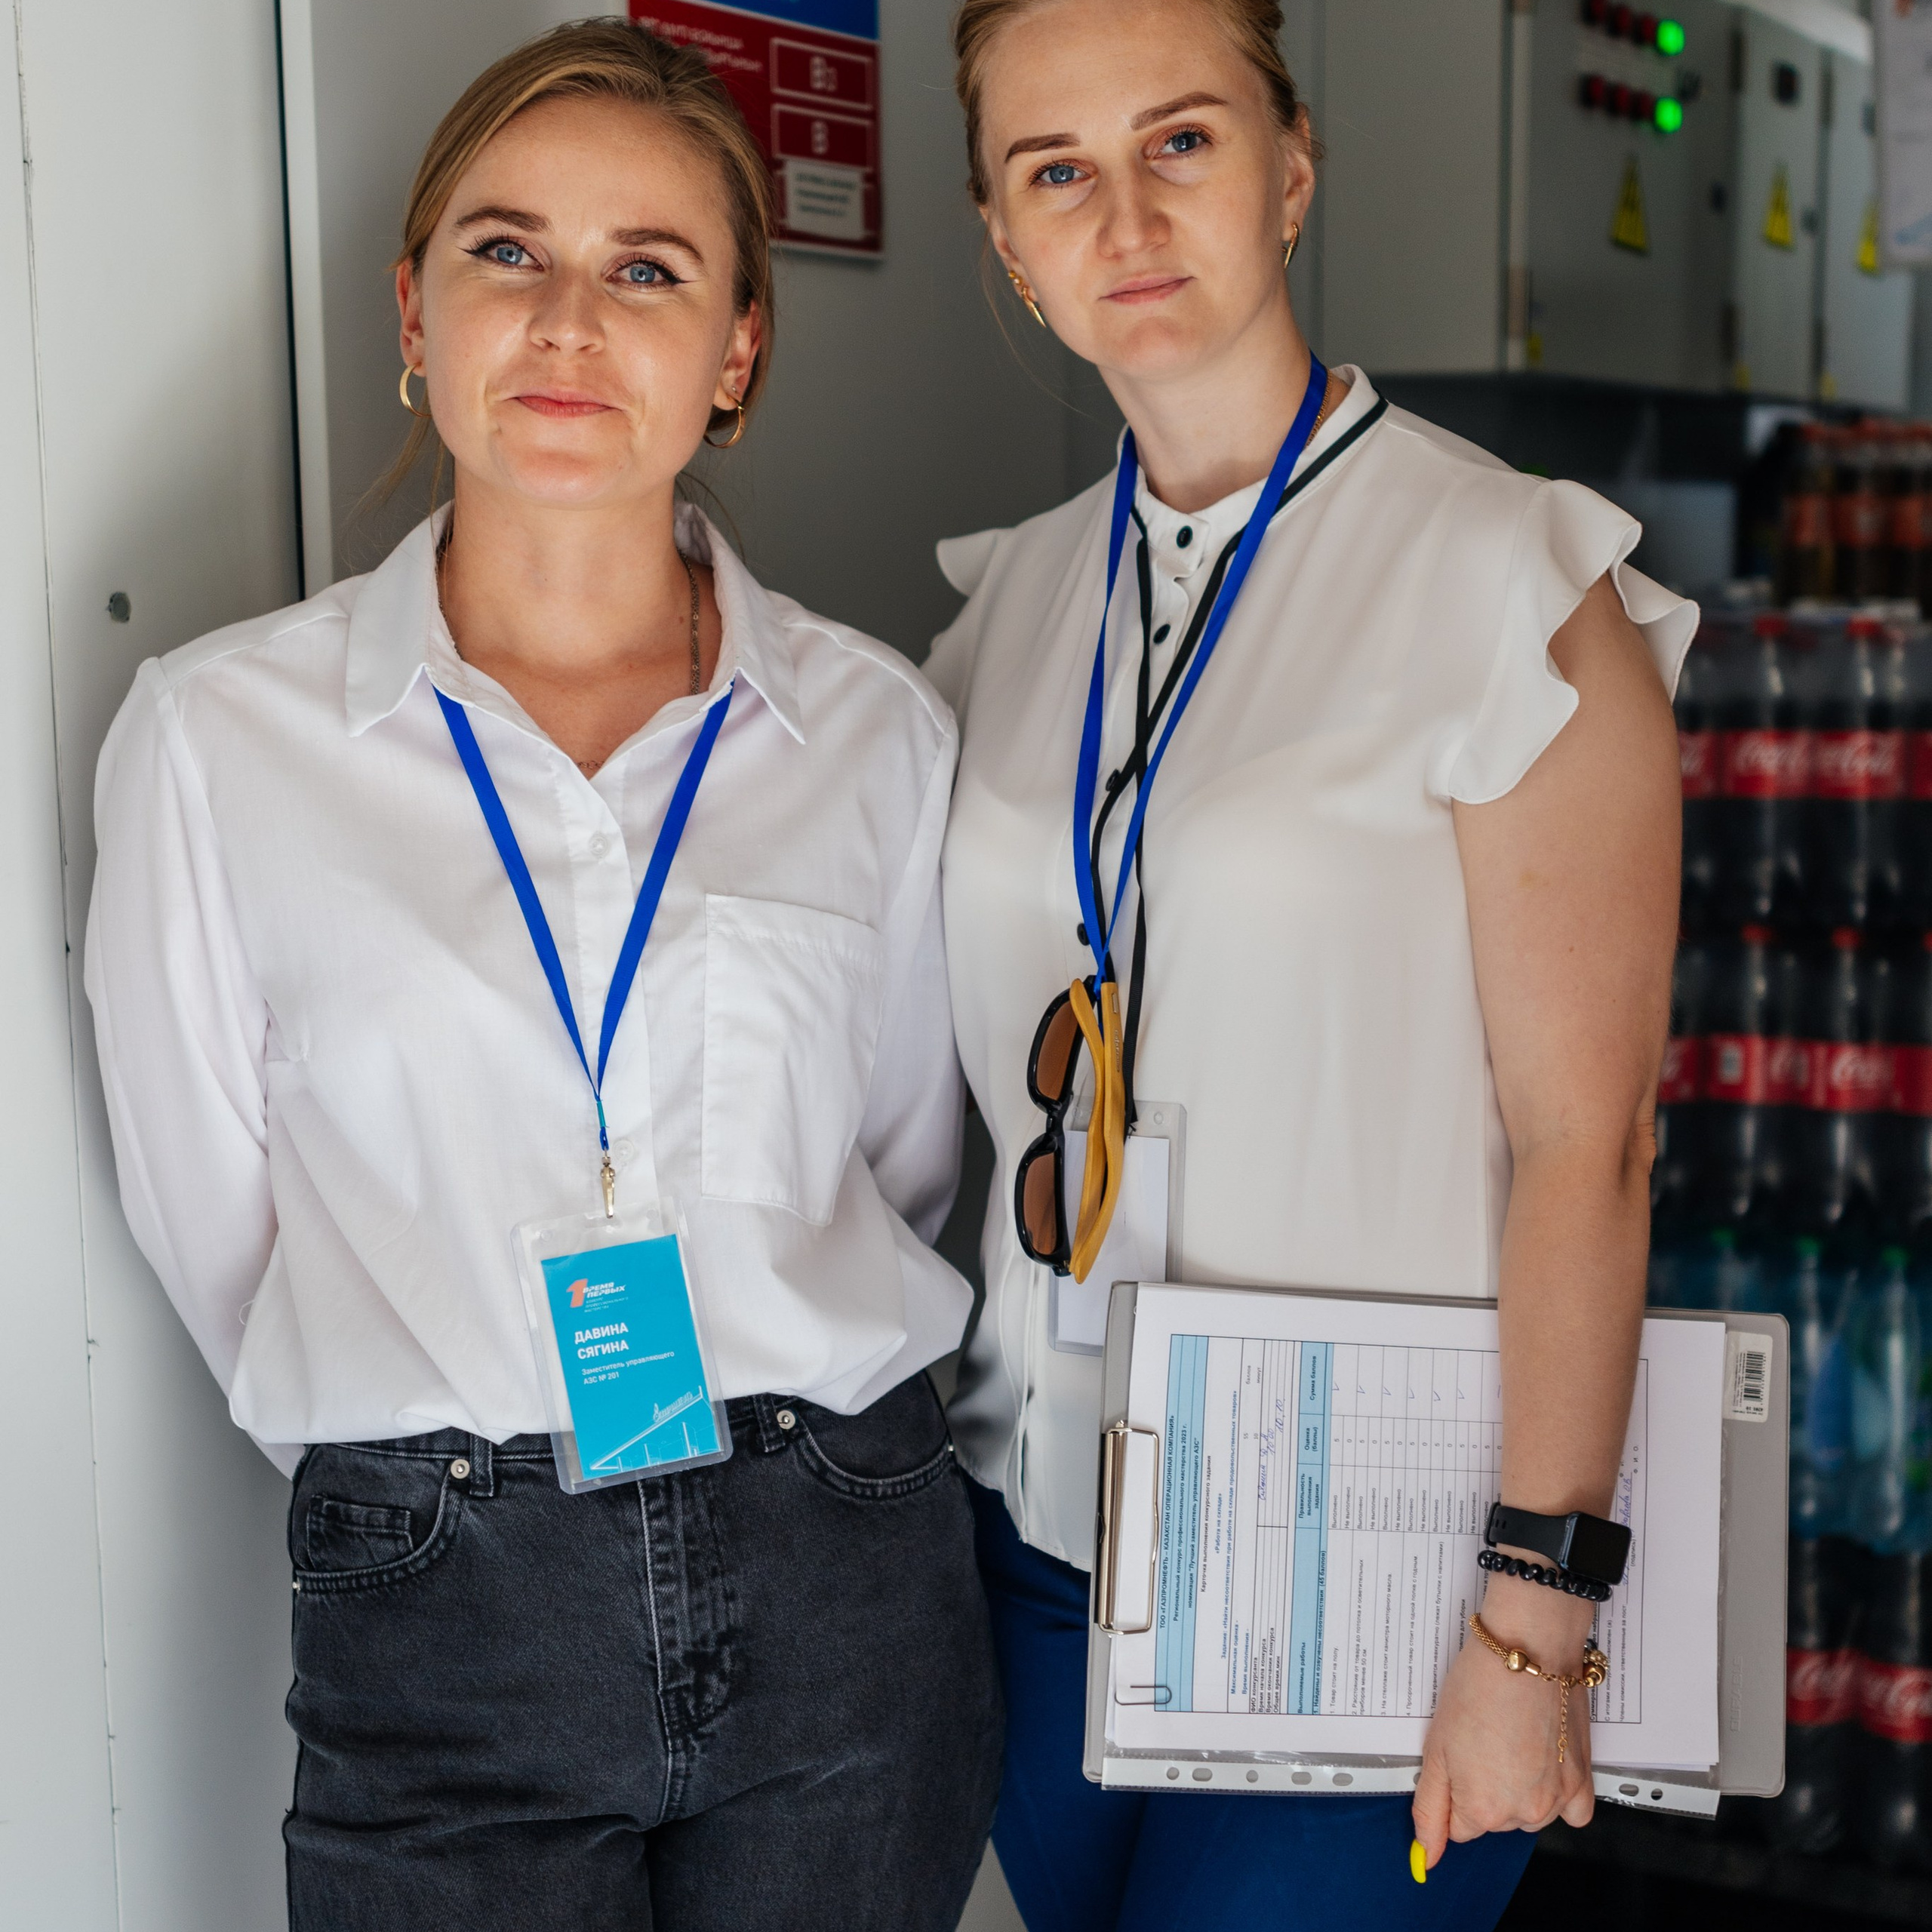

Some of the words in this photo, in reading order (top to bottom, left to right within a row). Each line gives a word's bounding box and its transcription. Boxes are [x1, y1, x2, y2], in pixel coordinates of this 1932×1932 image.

[583, 1282, 614, 1294] ВРЕМЯ
[587, 1284, 626, 1298] ПЕРВЫХ
[574, 1322, 629, 1345] ДАВИНА
[577, 1340, 629, 1359] СЯГИНА
[582, 1362, 625, 1376] Заместитель
[626, 1351, 675, 1367] управляющего
[583, 1376, 598, 1385] АЗС
[598, 1374, 607, 1382] №
[608, 1371, 620, 1380] 201
[1228, 1422, 1237, 1486] продовольственных
[1164, 1457, 1173, 1511] ОПЕРАЦИОННАЯ
[1192, 1456, 1200, 1502] управляющего
[1204, 1483, 1212, 1521] конкурсного
[1298, 1473, 1307, 1518] Правильность
[1176, 1483, 1186, 1547] профессионального
[1344, 1521, 1350, 1529] Не
[1189, 1545, 1197, 1571] "Лучший
[1437, 1541, 1445, 1574] напитками)
[1629, 1540, 1638, 1567] (подпись)
[1160, 1558, 1169, 1614] «ГАЗПРОМНЕФТЬ
[1385, 1594, 1393, 1624] моторного
[1434, 1606, 1442, 1626] (лежат
[1383, 1626, 1392, 1652] канистра
[1300, 1642, 1308, 1666] работы
[1230, 1648, 1238, 1694] Максимальная
[1251, 1657, 1260, 1696] конкурсанта
[1330, 1690, 1338, 1706] Товар
[1406, 1666, 1414, 1709] Просроченный
[1258, 1693, 1266, 1712] Время
[1266, 1693, 1274, 1712] Время
